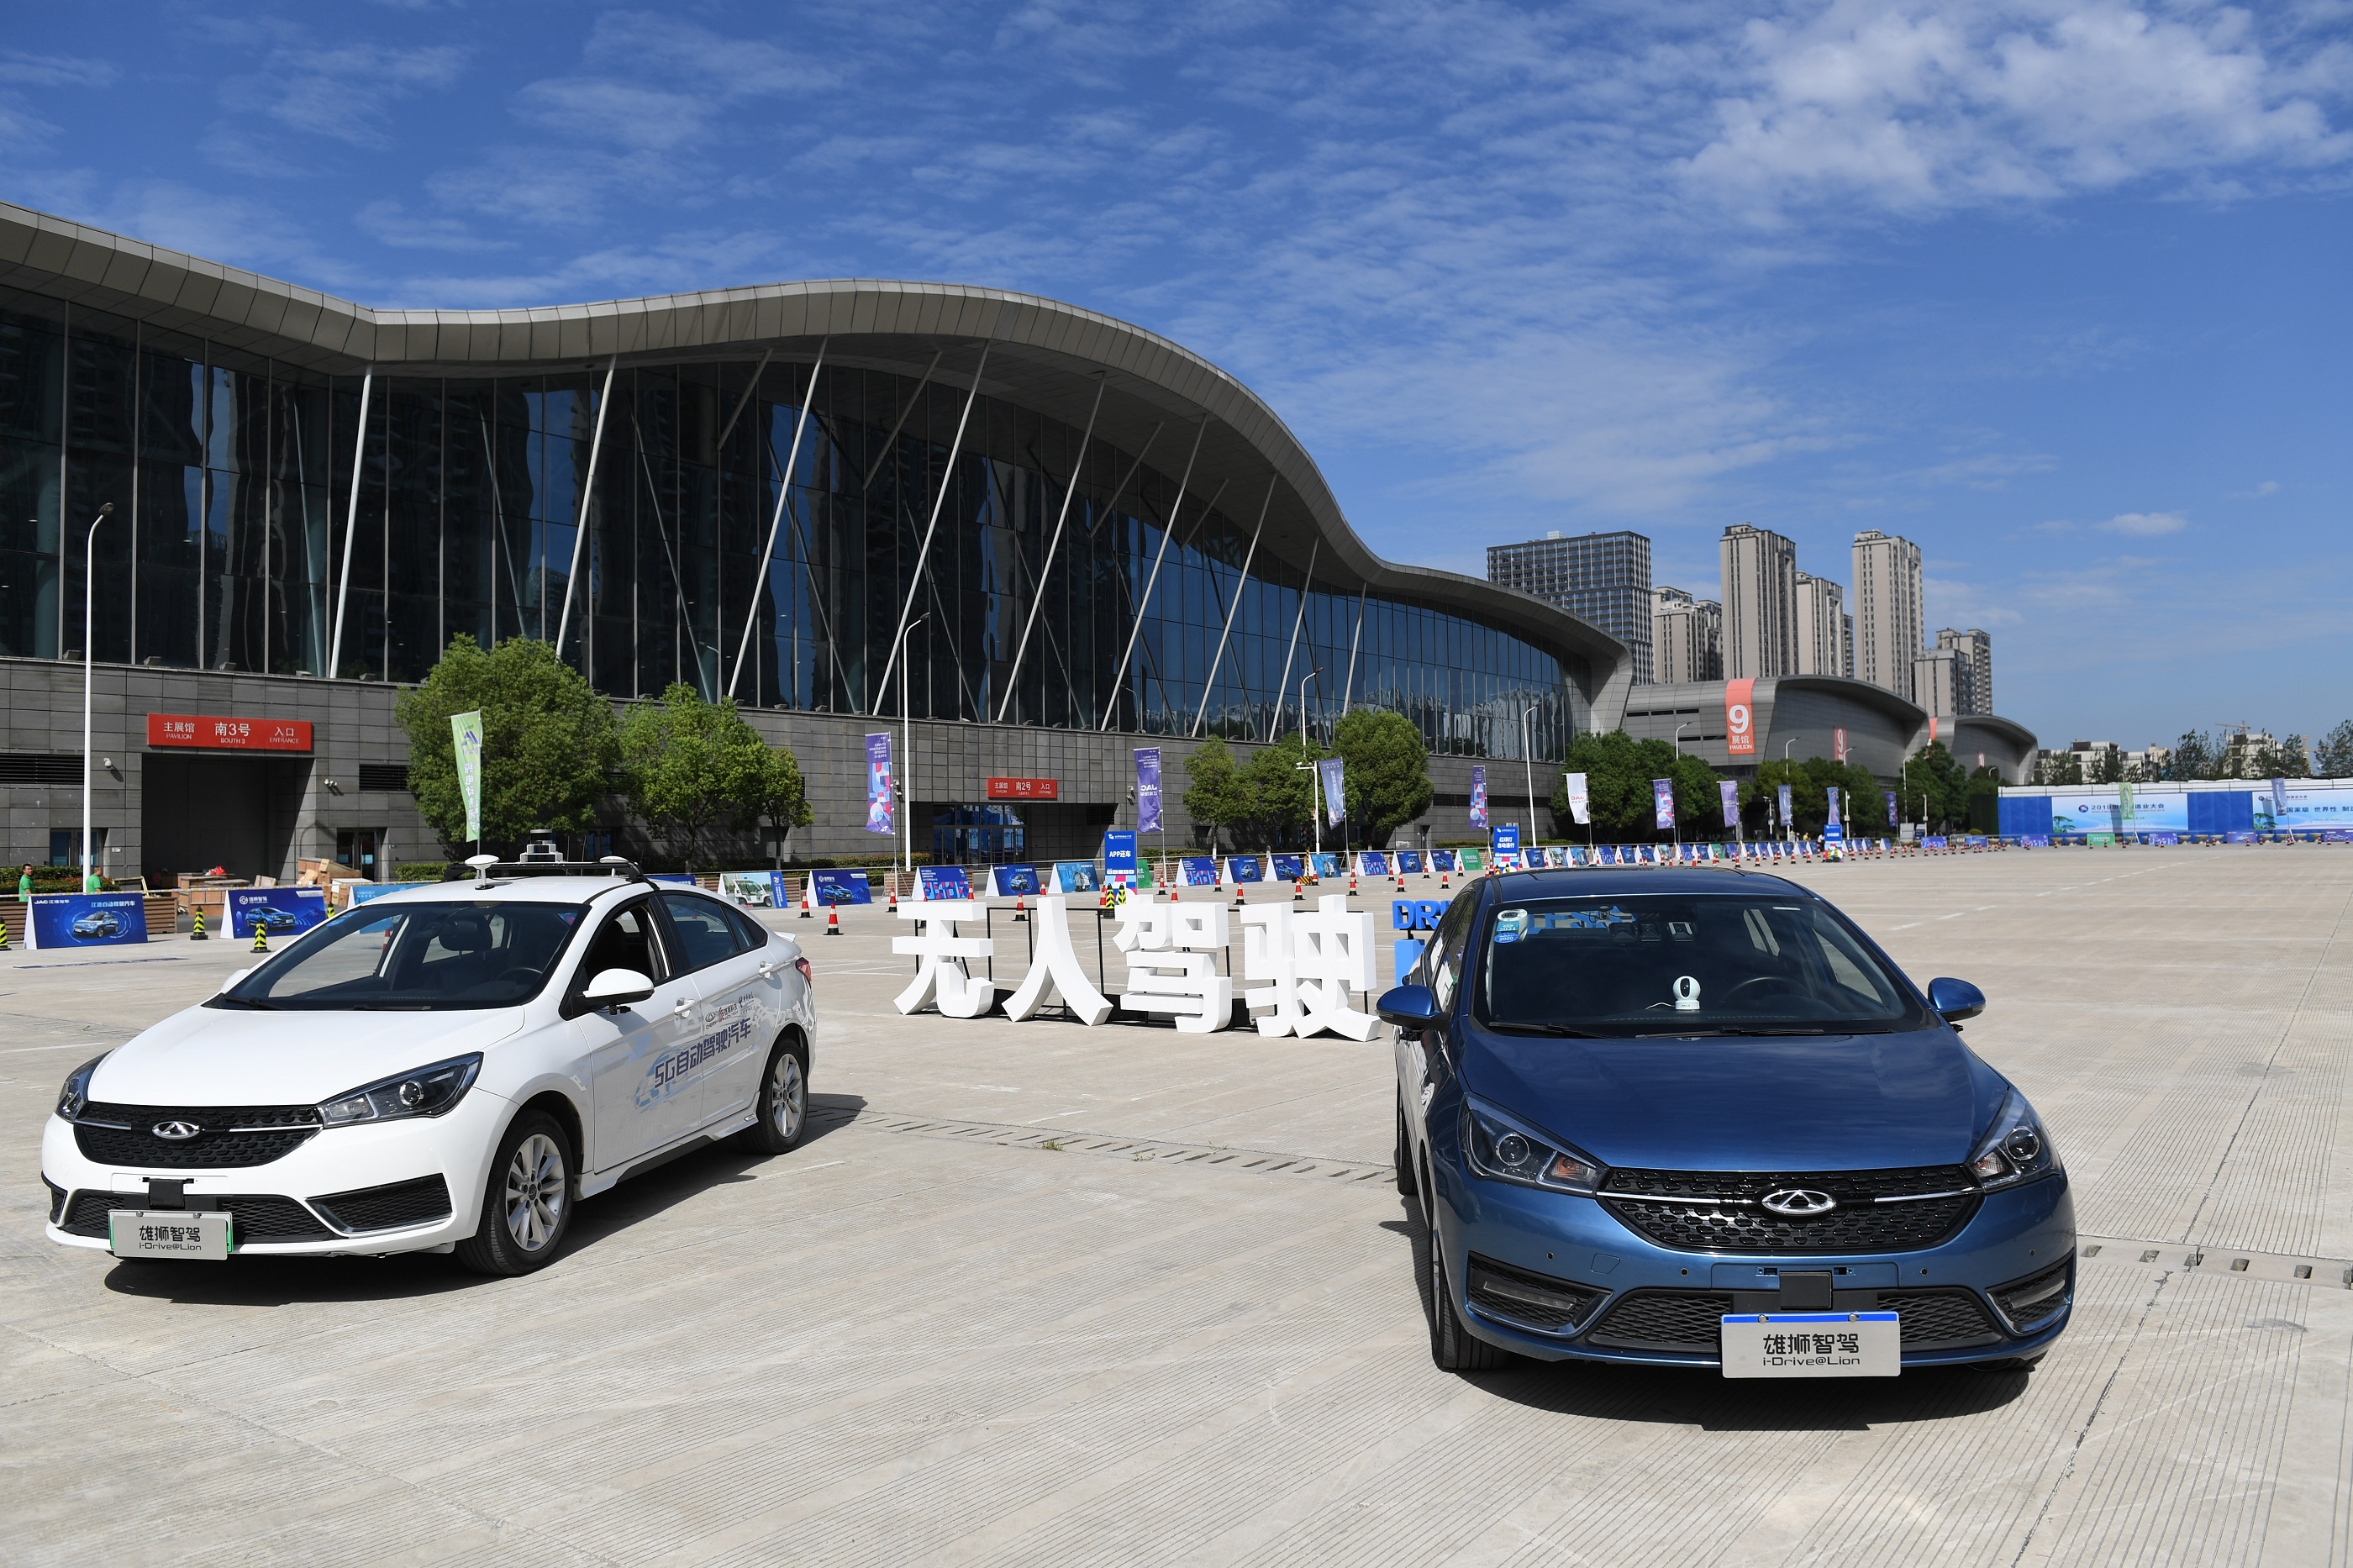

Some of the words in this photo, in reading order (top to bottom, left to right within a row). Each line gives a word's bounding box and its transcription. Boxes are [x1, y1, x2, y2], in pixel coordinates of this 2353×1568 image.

[1729, 704, 1749, 734] 9
[163, 722, 195, 733] 主展馆
[214, 722, 251, 737] 南3号
[274, 727, 294, 737] 入口
[1732, 735, 1749, 745] 展馆
[1838, 729, 1844, 753] 9
[2092, 802, 2165, 811] 2019世造业大会
[892, 893, 1382, 1042] 无人驾驶
[655, 1017, 751, 1089] 5G自动驾驶汽车
[139, 1225, 201, 1242] 雄狮智驾
[139, 1242, 202, 1250] i-Drive@Lion
[1762, 1333, 1860, 1355] 雄狮智驾
[1762, 1356, 1861, 1366] i-Drive@Lion
